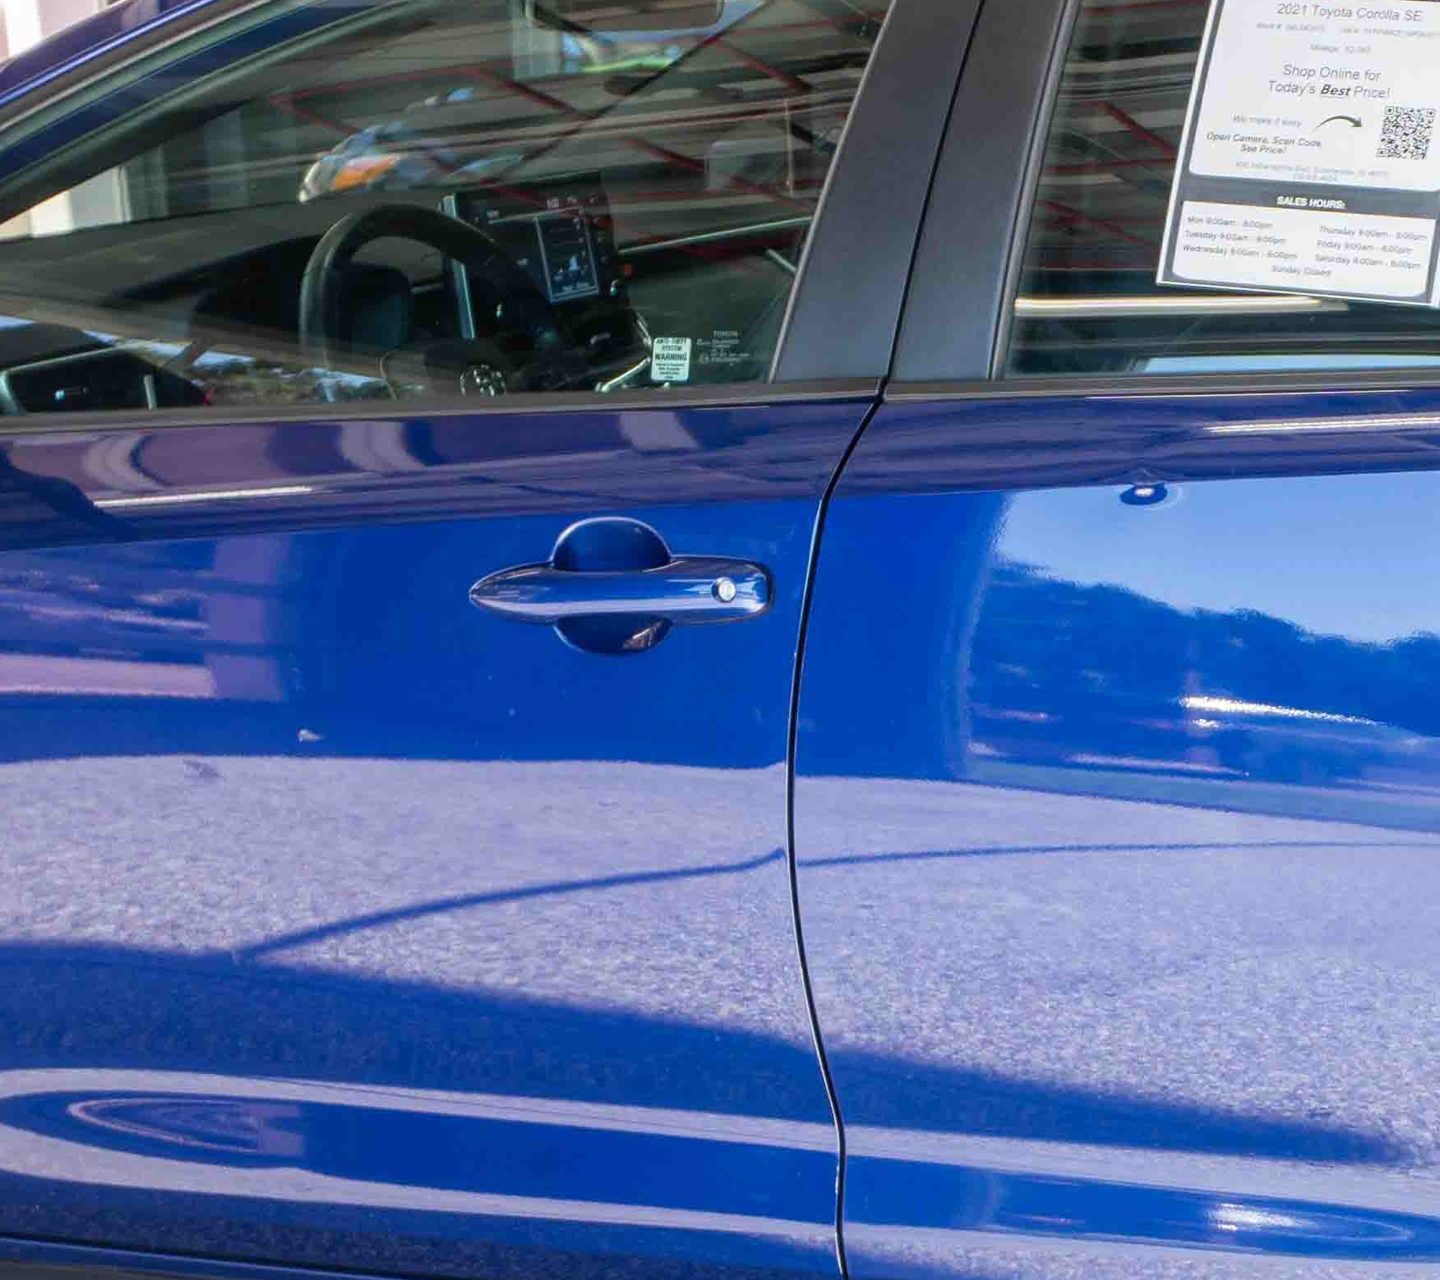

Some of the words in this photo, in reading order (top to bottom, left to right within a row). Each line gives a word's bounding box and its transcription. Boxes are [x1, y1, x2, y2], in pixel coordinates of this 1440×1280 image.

[1277, 2, 1307, 16] 2021
[1312, 4, 1353, 19] Toyota
[1356, 7, 1400, 21] Corolla
[1405, 9, 1423, 22] SE
[1282, 64, 1317, 80] Shop
[1319, 66, 1360, 80] Online
[1364, 69, 1382, 81] for
[1268, 81, 1316, 97] Today's
[1320, 84, 1351, 96] Best
[1354, 86, 1391, 98] Price!
[1206, 131, 1230, 142] Open
[1271, 136, 1295, 146] Scan
[1240, 143, 1258, 153] See
[1276, 196, 1308, 207] SALES
[655, 352, 688, 361] WARNING
